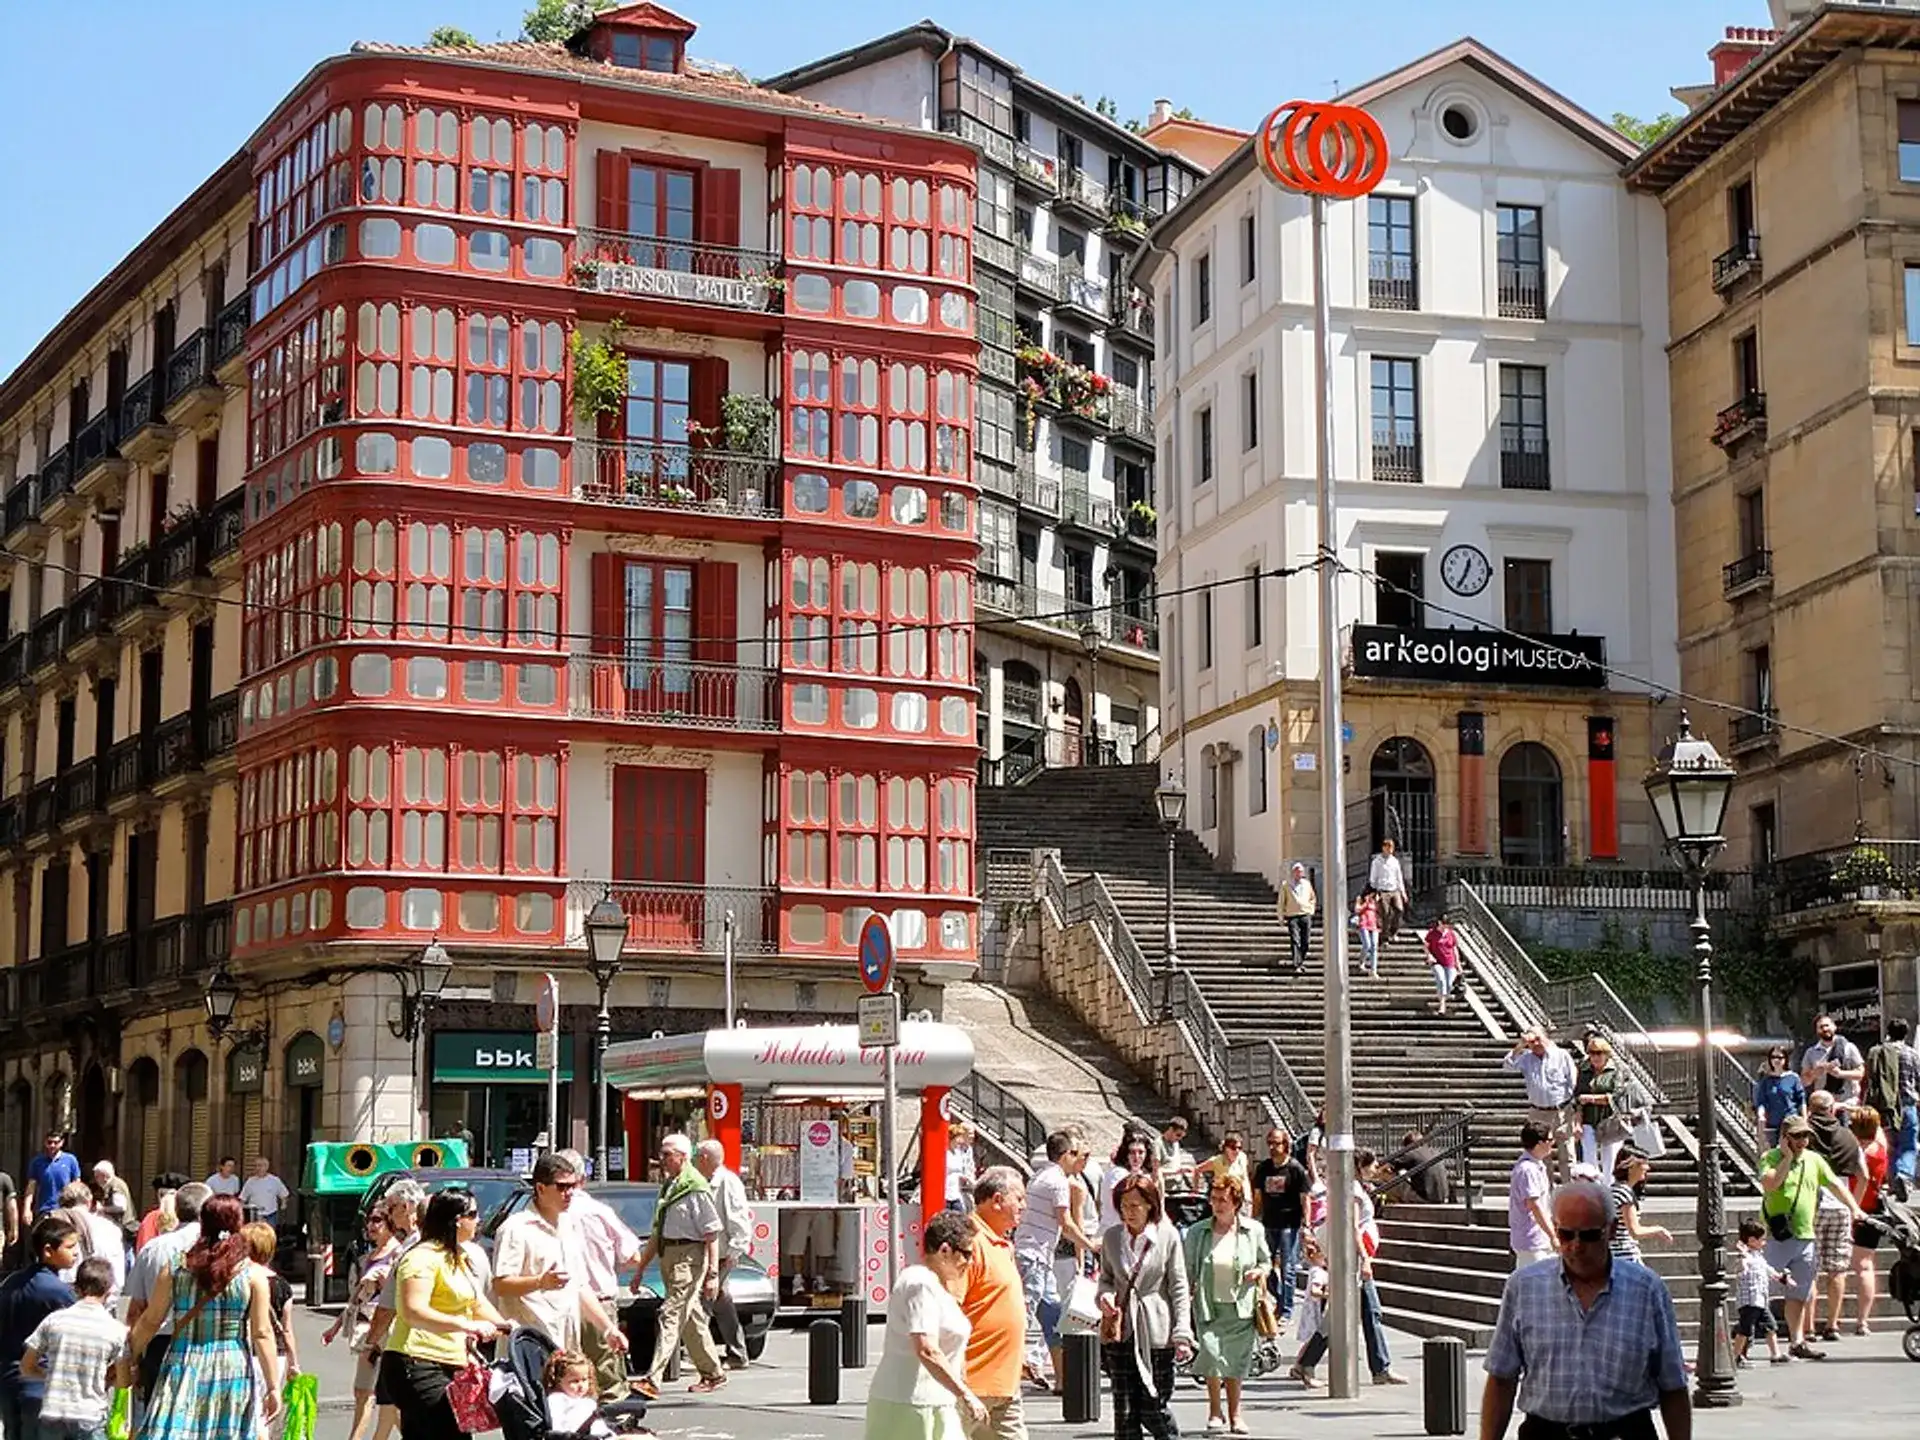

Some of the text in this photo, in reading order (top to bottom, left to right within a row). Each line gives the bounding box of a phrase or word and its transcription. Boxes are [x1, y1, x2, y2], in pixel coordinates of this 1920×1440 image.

[611, 270, 679, 296] PENSION
[1365, 634, 1592, 671] arkeologi MUSEOA
[475, 1049, 533, 1067] bbk
[753, 1037, 846, 1066] Helados
[240, 1066, 257, 1081] bbk
[297, 1058, 317, 1075] bbk
[714, 1096, 724, 1113] B
